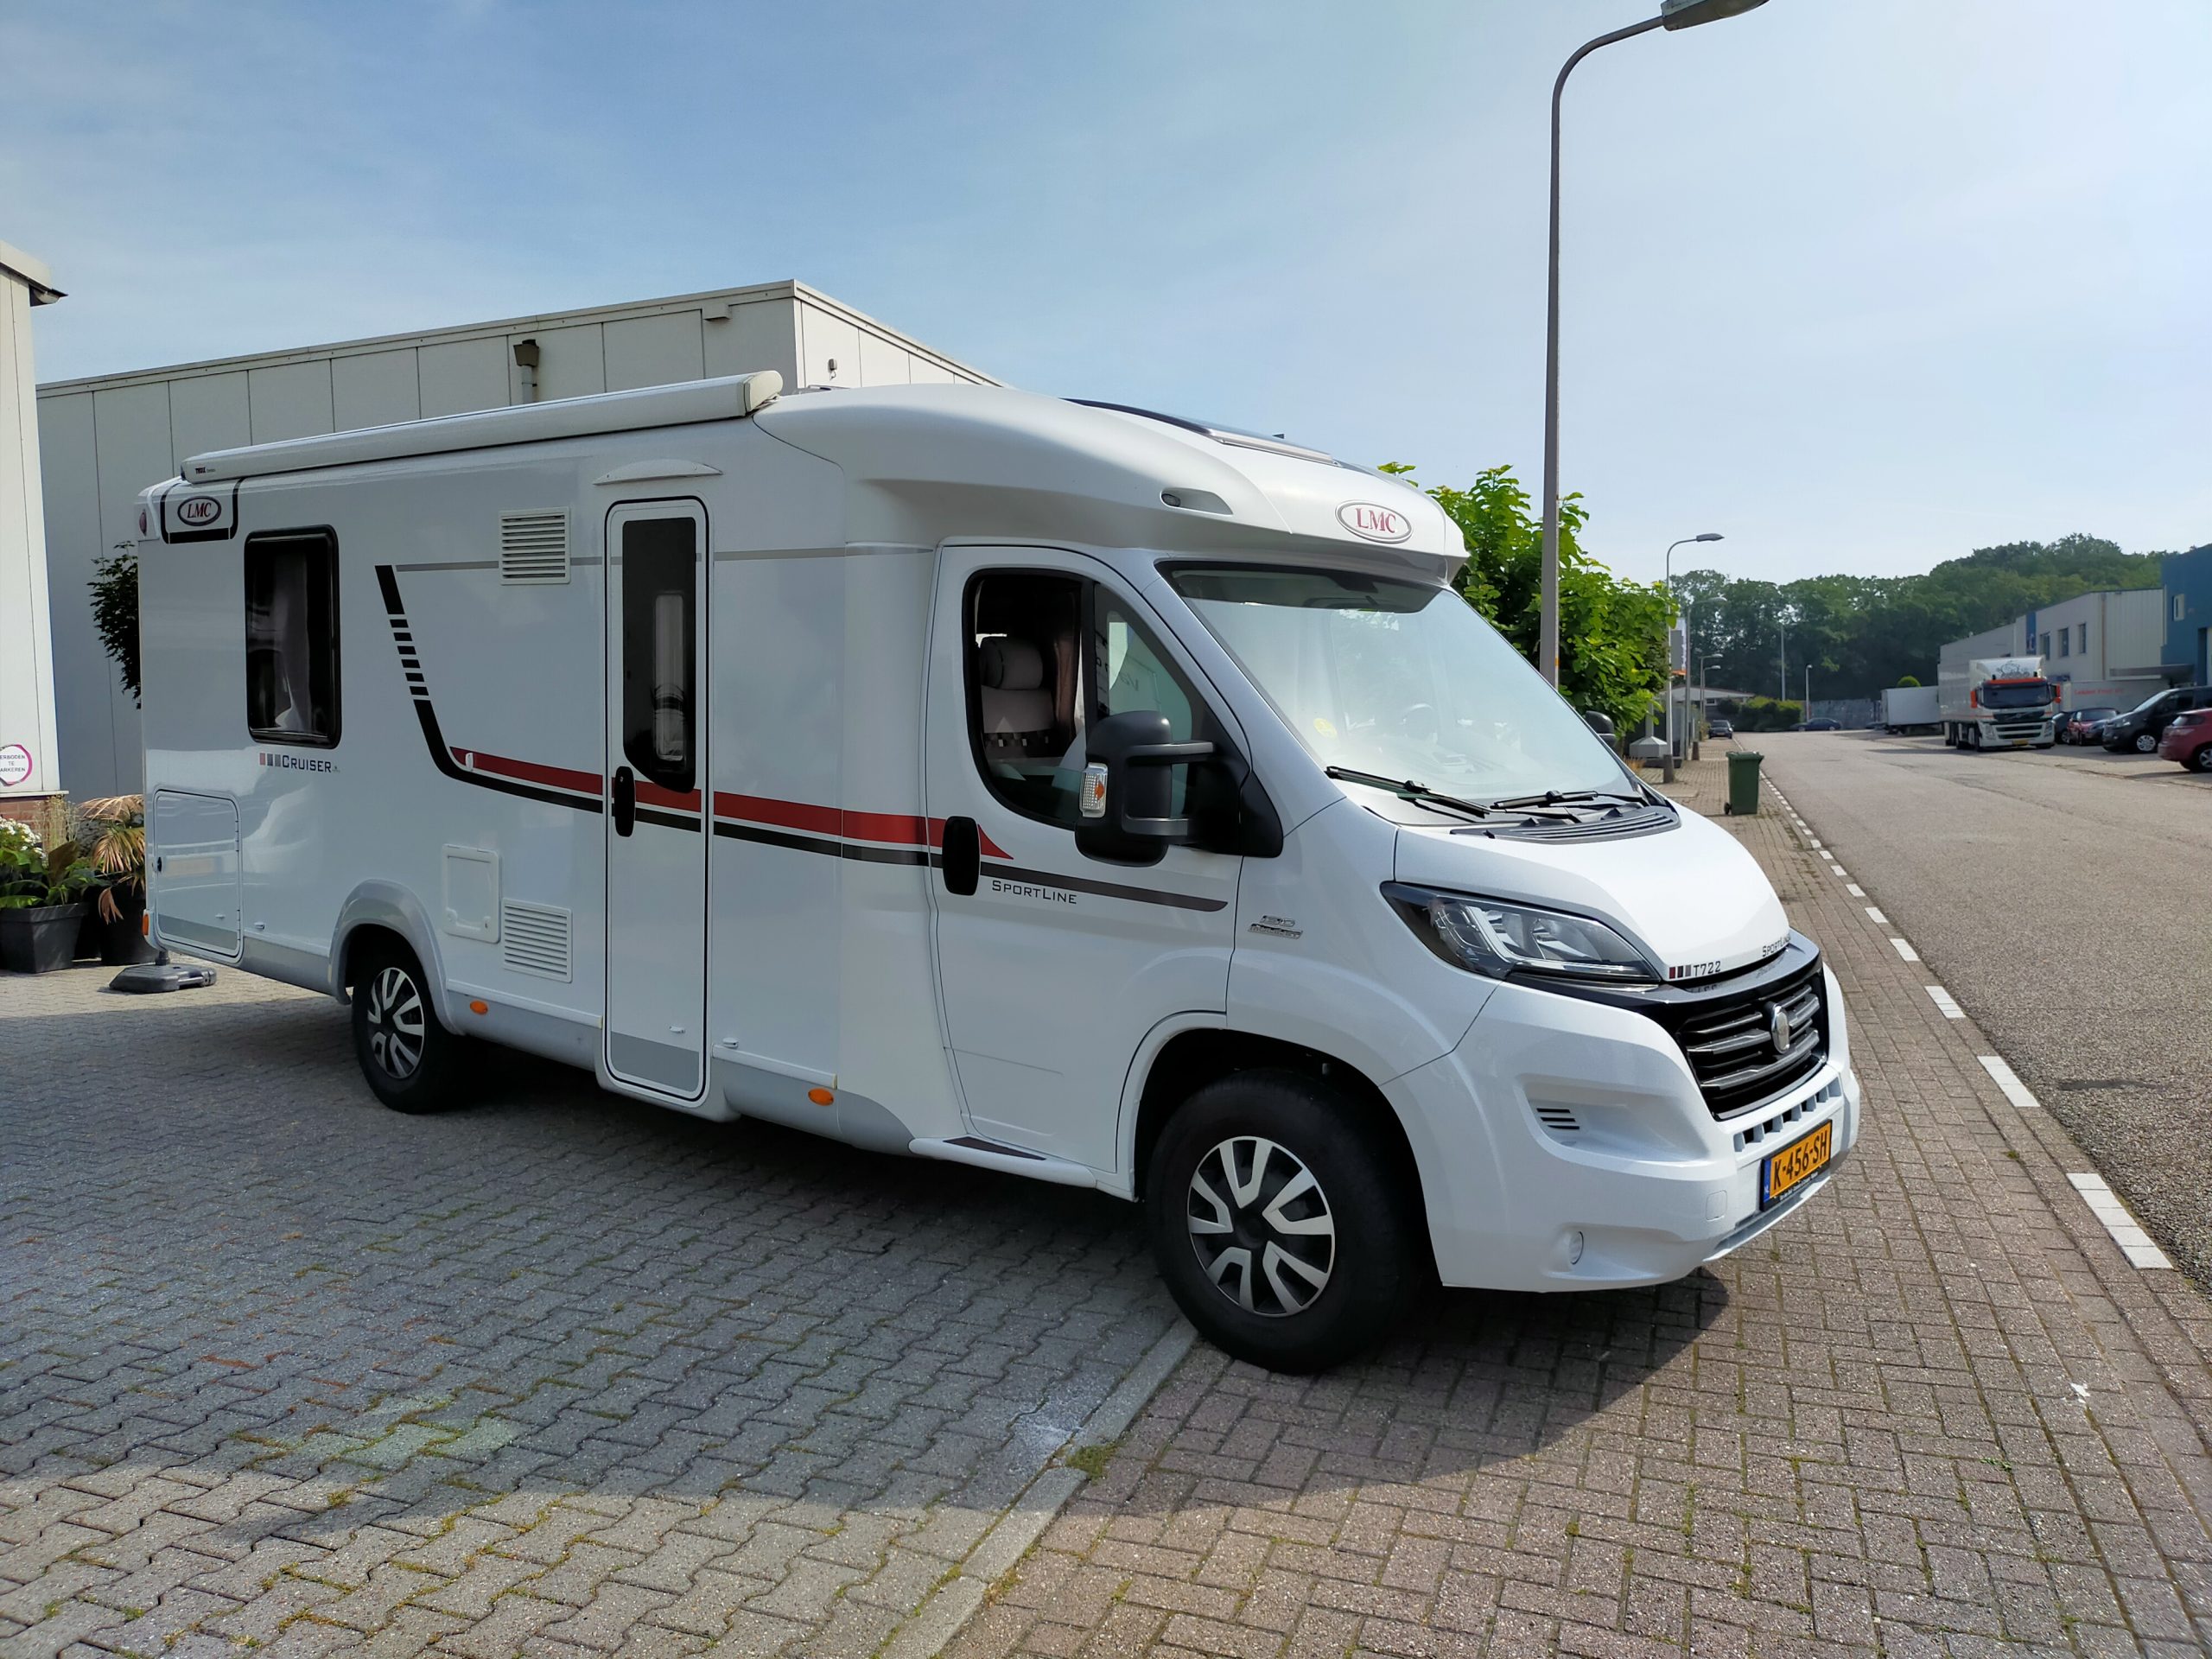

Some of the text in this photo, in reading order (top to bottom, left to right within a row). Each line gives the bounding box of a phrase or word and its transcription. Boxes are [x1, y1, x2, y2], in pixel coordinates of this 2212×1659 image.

[187, 502, 212, 518] LMC
[1355, 507, 1396, 533] LMC
[992, 880, 1077, 905] SPORTLINE
[1694, 961, 1721, 977] T722
[1773, 1130, 1827, 1191] K-456-SH
